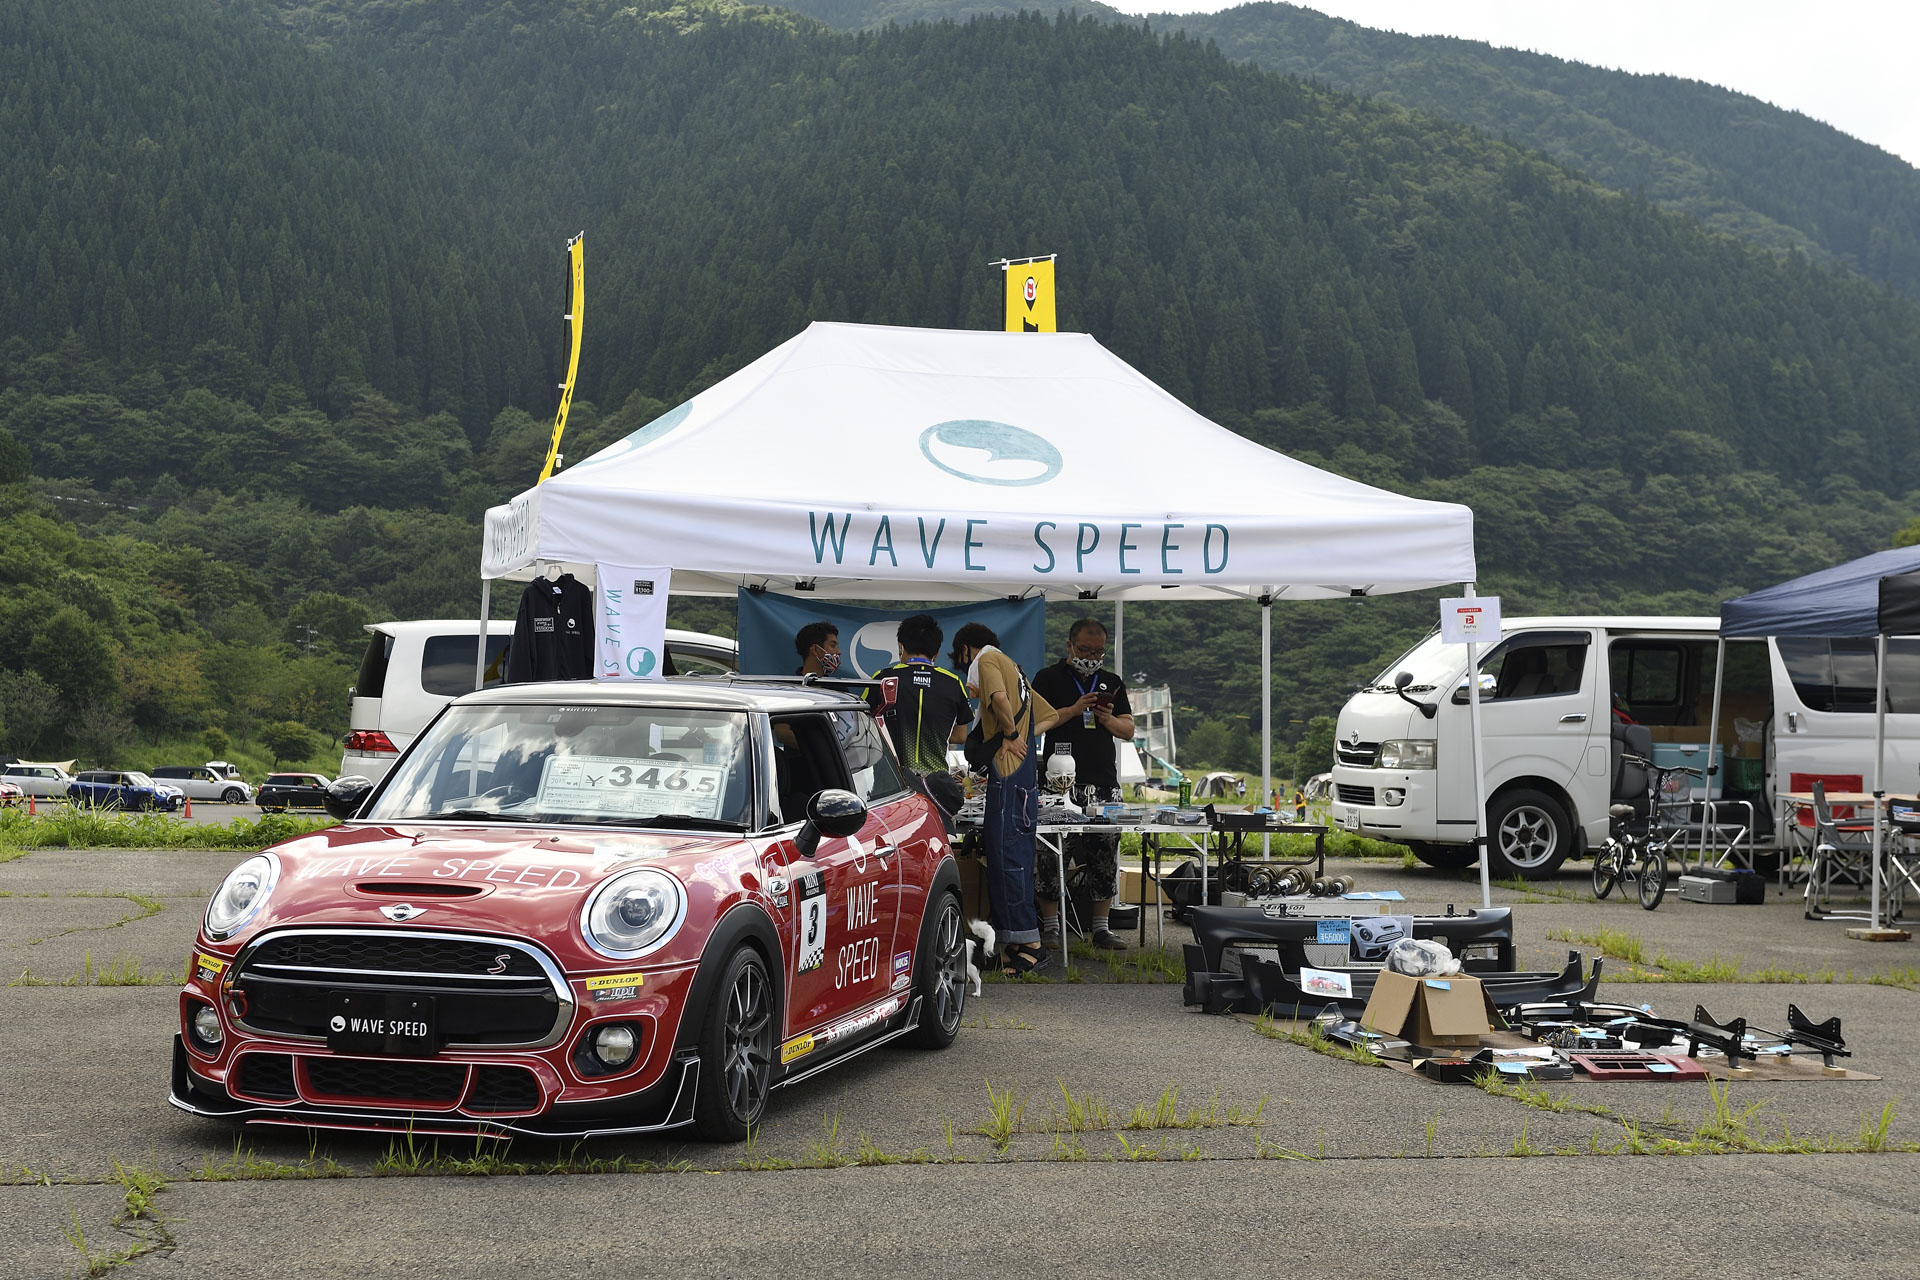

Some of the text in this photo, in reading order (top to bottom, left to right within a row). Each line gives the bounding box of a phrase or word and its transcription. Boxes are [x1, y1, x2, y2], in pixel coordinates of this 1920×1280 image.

[808, 511, 1230, 575] WAVE SPEED
[606, 589, 623, 648] WAVE
[913, 675, 931, 684] MINI
[295, 857, 581, 888] WAVE SPEED
[804, 872, 819, 890] MINI
[847, 880, 879, 931] WAVE
[808, 901, 819, 947] 3
[202, 957, 221, 969] DUNLOP
[835, 936, 879, 990] SPEED
[597, 976, 639, 986] DUNLOP
[350, 1017, 427, 1037] WAVE SPEED
[787, 1040, 812, 1056] DUNLOP
